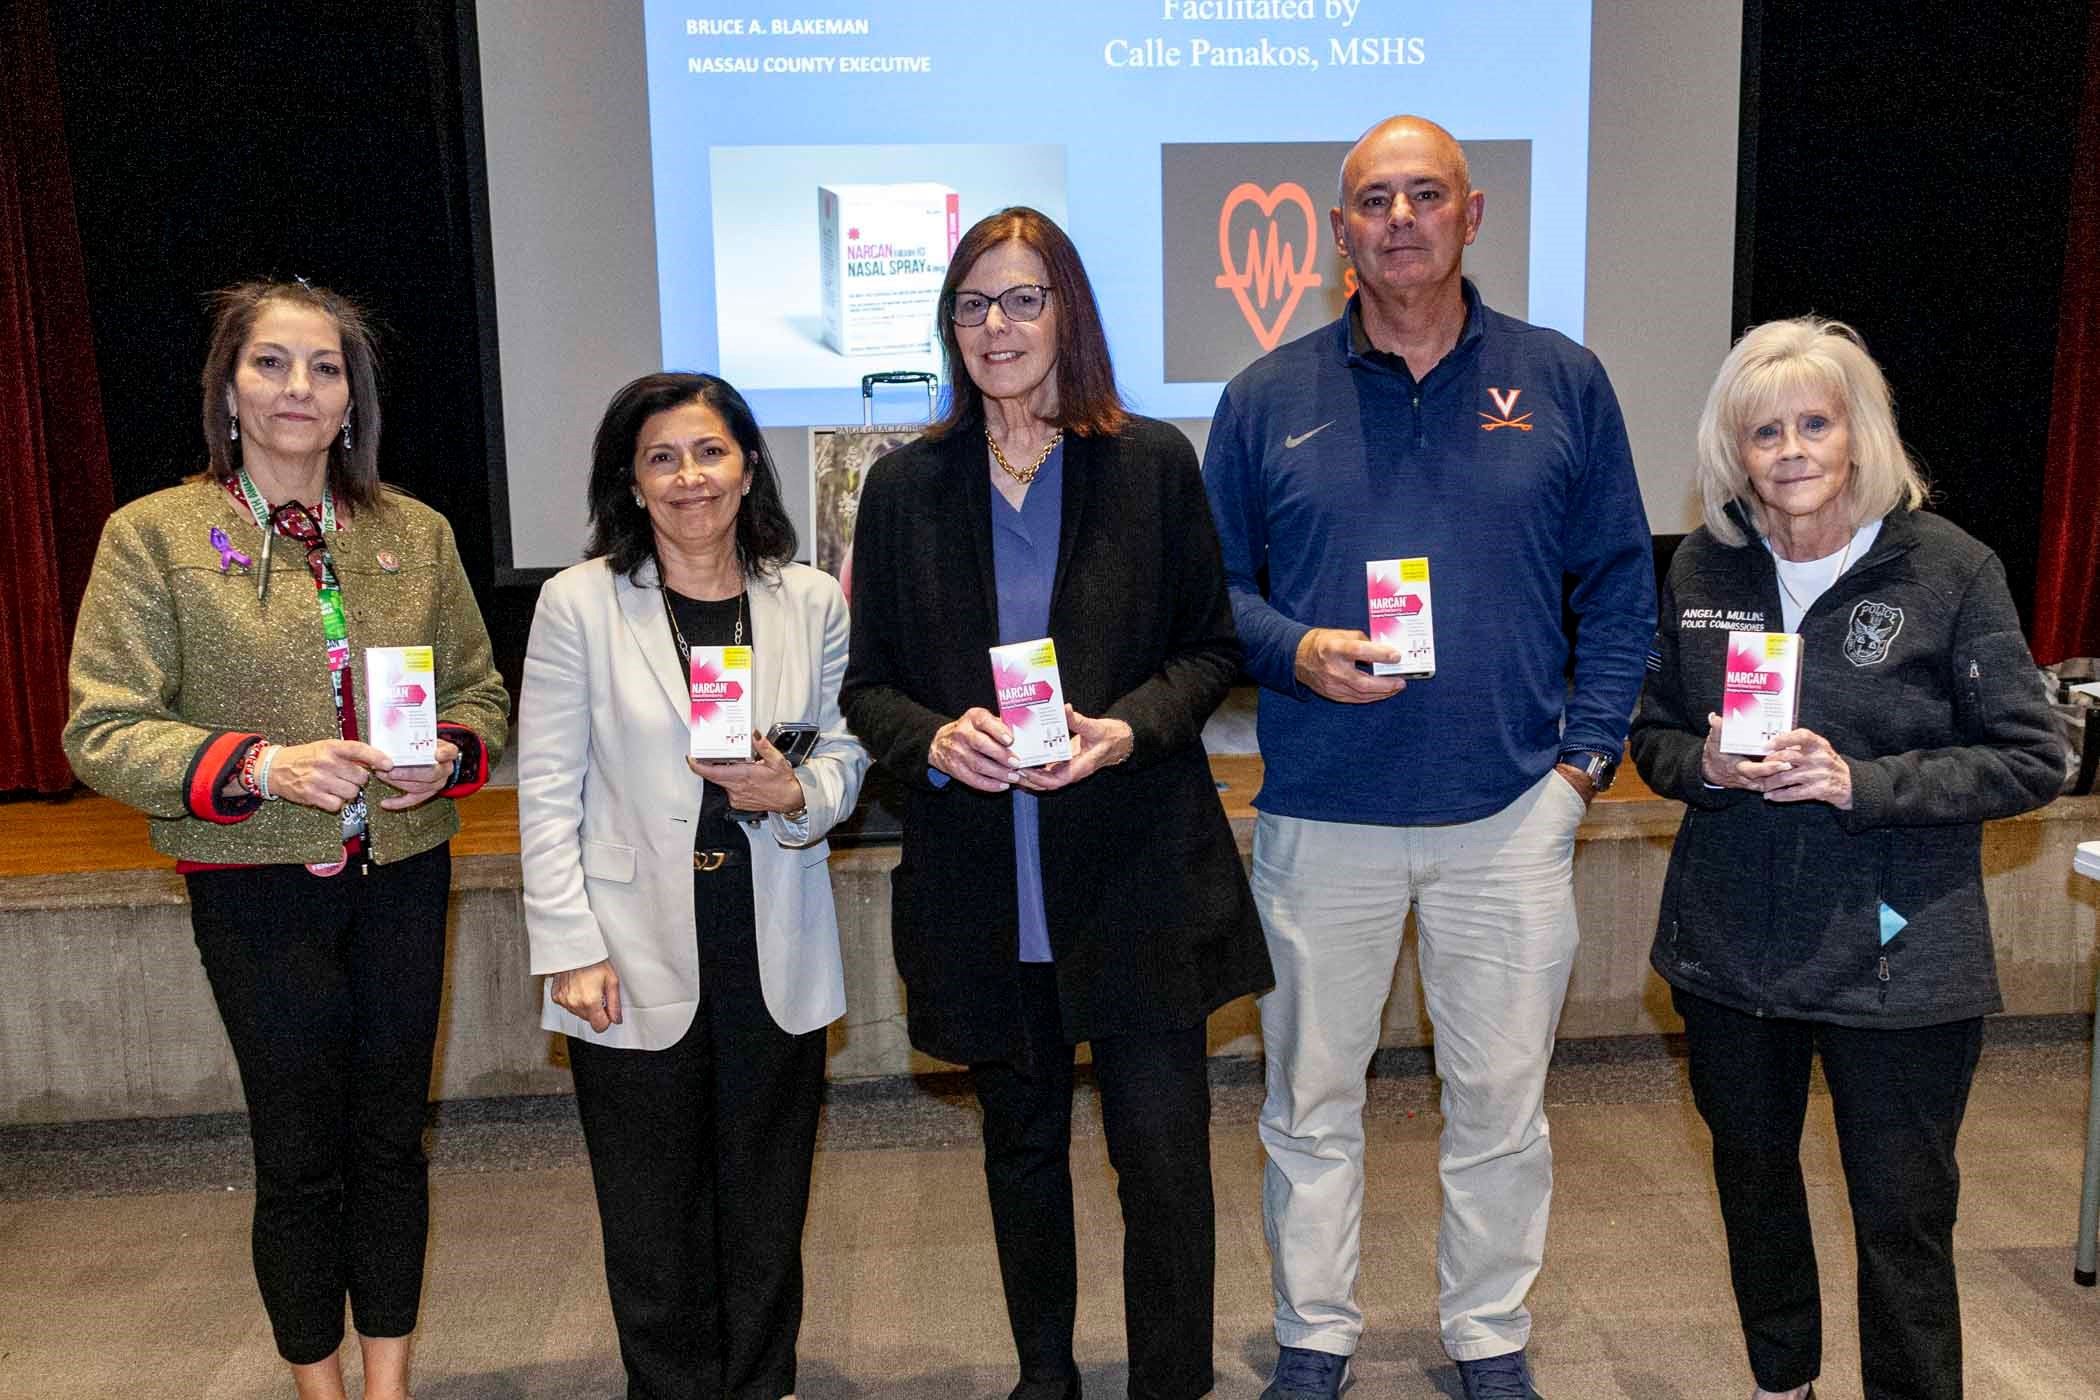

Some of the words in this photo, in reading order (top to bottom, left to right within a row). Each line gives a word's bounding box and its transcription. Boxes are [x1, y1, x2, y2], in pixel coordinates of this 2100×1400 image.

[1162, 0, 1315, 20] Facilitated
[1325, 0, 1361, 27] by
[686, 18, 744, 36] BRUCE
[748, 18, 767, 36] A.
[771, 18, 869, 36] BLAKEMAN
[1103, 38, 1181, 67] Calle
[1190, 38, 1319, 72] Panakos,
[1328, 37, 1425, 66] MSHS
[688, 56, 759, 73] NASSAU
[763, 56, 835, 73] COUNTY
[839, 56, 932, 73] EXECUTIVE
[847, 244, 893, 261] NARCAN
[847, 261, 886, 278] NASAL
[889, 258, 927, 275] SPRAY
[1369, 596, 1408, 609] NARCAN
[1682, 609, 1723, 618] ANGELA
[1859, 605, 1898, 625] POLICE
[1681, 620, 1707, 629] POLICE
[1727, 671, 1768, 685] NARCAN
[691, 682, 729, 695] NARCAN
[998, 684, 1037, 701] NARCAN
